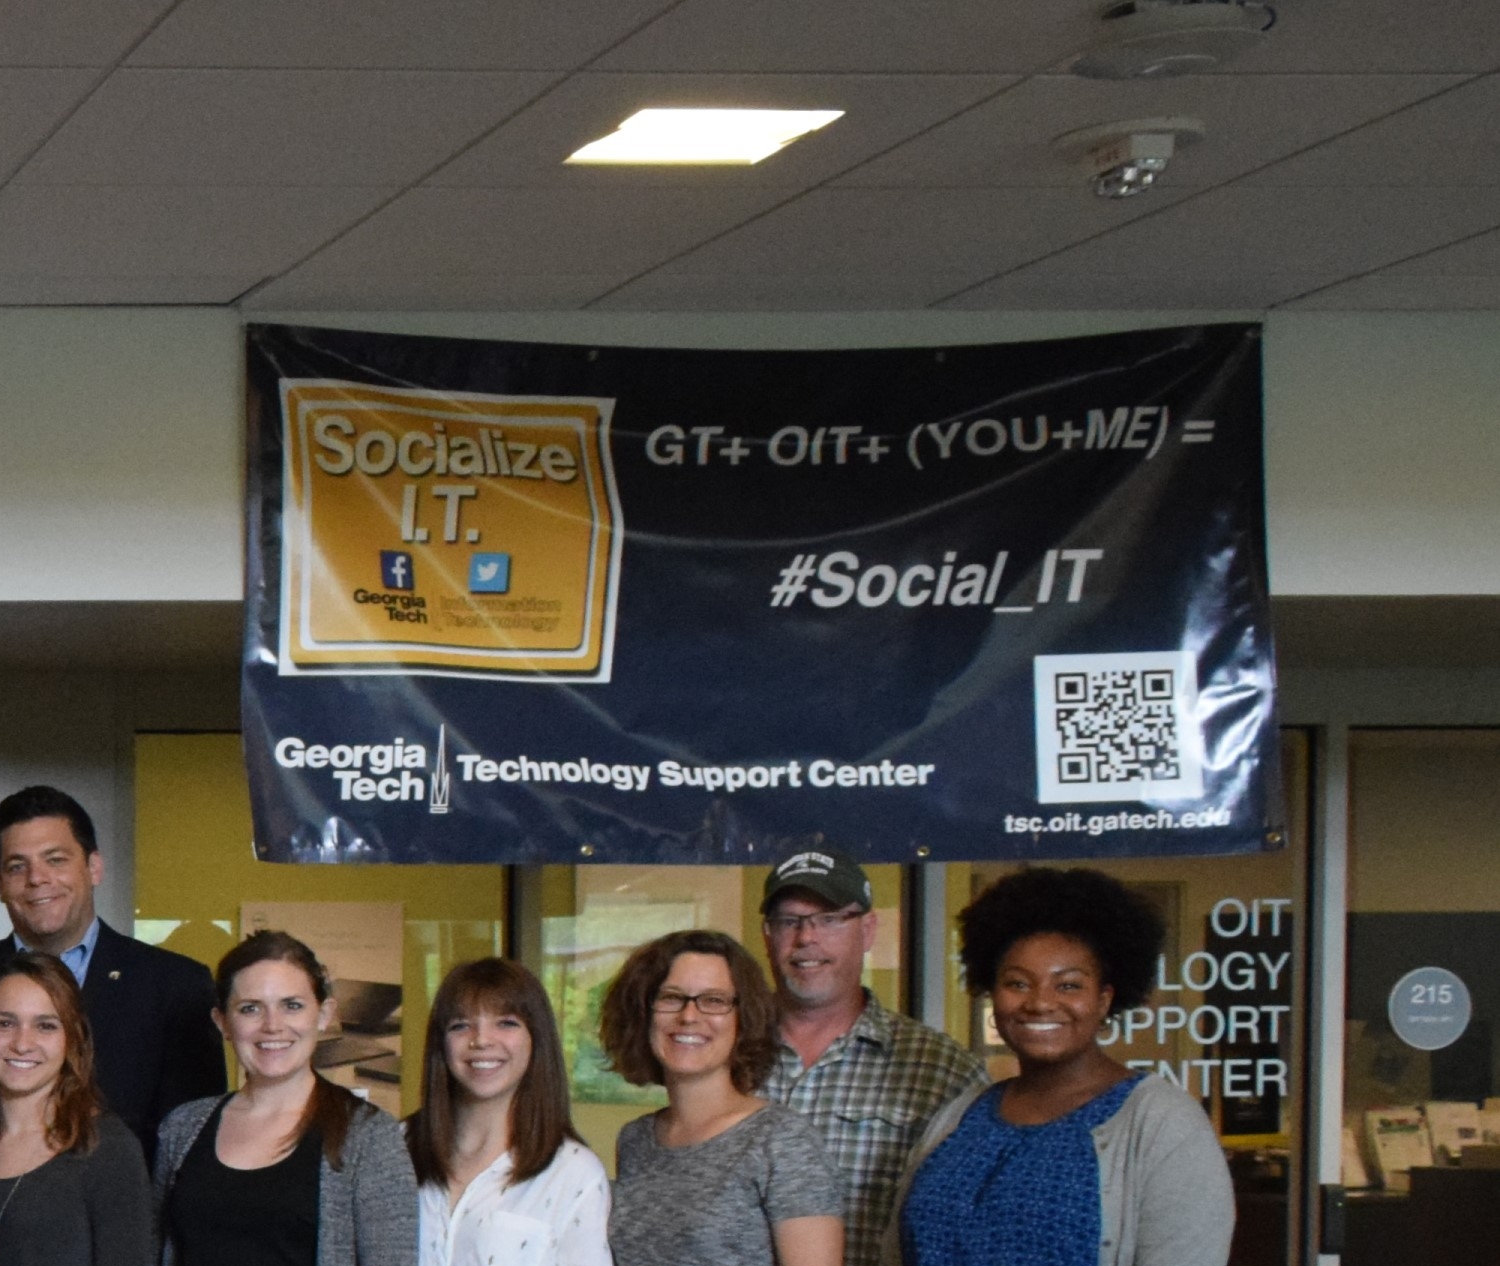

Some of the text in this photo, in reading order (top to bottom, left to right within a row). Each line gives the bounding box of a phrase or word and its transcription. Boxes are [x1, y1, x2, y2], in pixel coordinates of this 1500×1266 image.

[314, 415, 578, 482] Socialize
[646, 424, 750, 466] GT+
[768, 424, 890, 466] OIT+
[908, 405, 1169, 470] (YOU+ME)
[401, 484, 481, 543] I.T.
[353, 588, 427, 609] Georgia
[770, 548, 1104, 613] #Social_IT
[384, 605, 428, 625] Tech
[275, 737, 426, 776] Georgia
[456, 754, 935, 792] Technology Support Center
[333, 770, 425, 801] Tech
[1004, 806, 1231, 836] tsc.oit.gatech.edu
[1210, 898, 1292, 938] OIT
[1410, 983, 1454, 1005] 215
